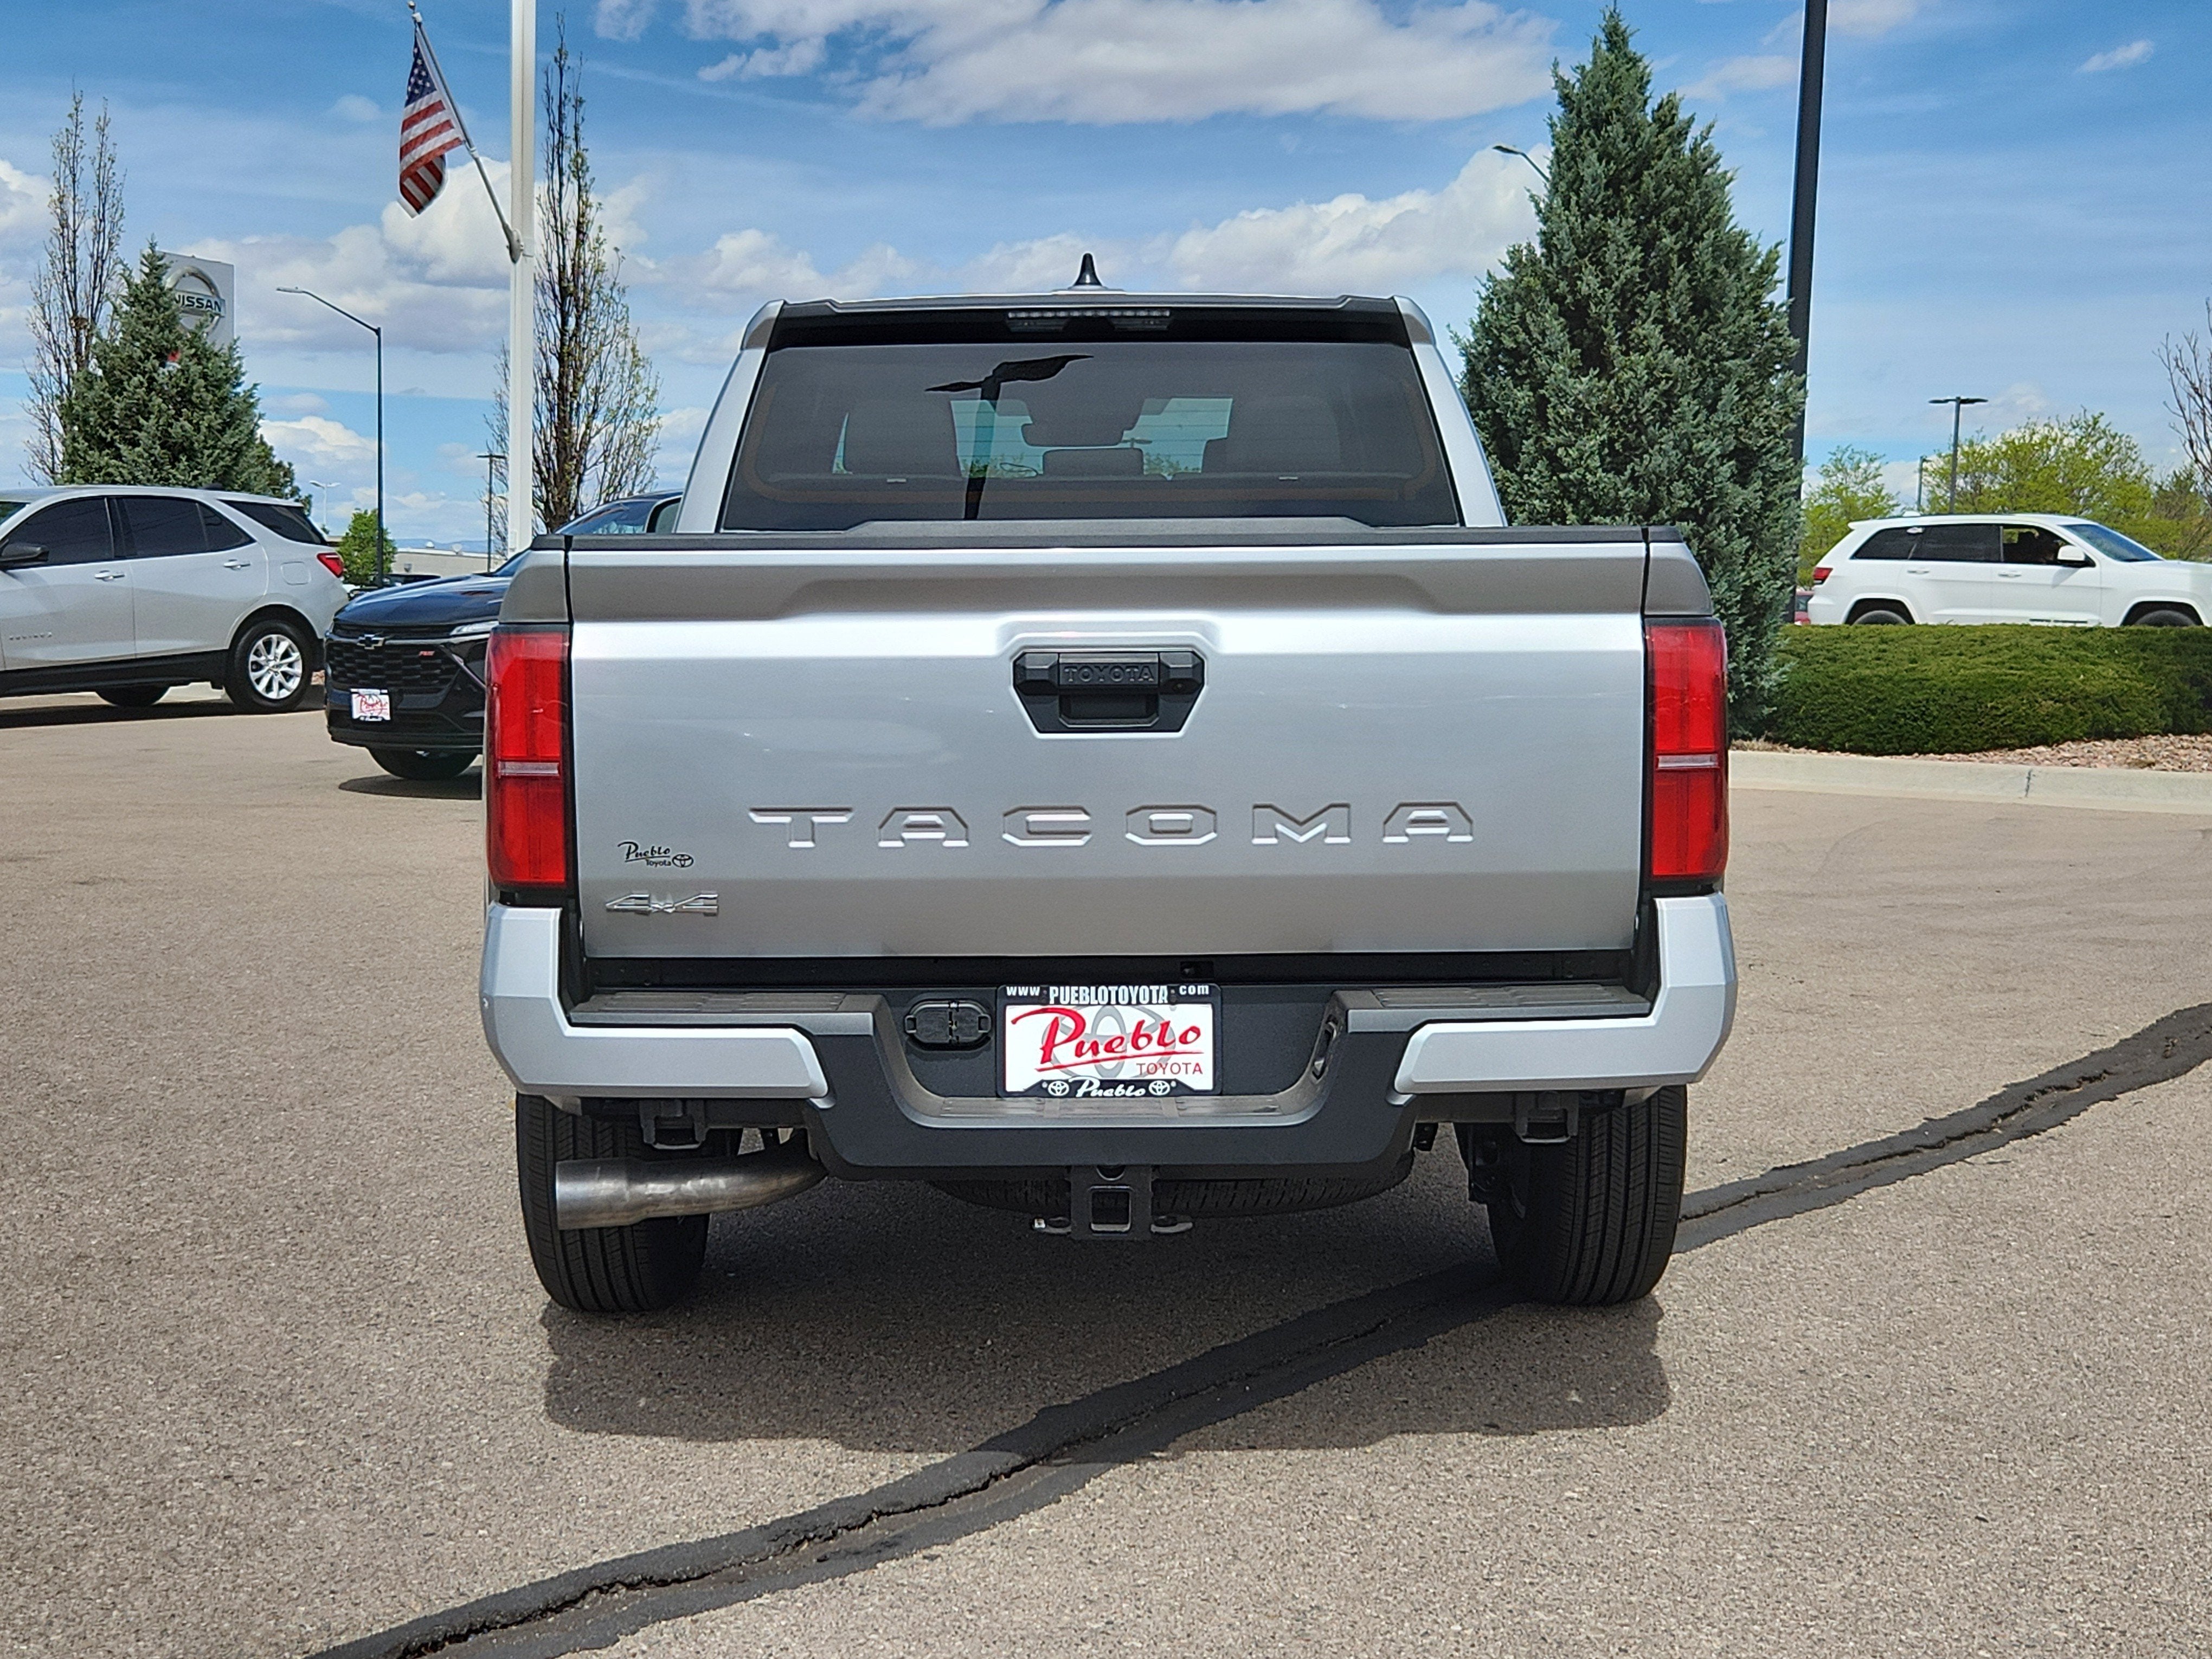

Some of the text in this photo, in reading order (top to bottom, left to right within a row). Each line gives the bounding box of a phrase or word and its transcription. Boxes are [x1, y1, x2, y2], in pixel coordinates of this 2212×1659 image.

[173, 294, 221, 312] NISSAN
[1064, 665, 1154, 682] TOYOTA
[749, 802, 1474, 848] TACOMA
[618, 841, 671, 859] Pueblo
[646, 859, 672, 867] Toyota
[1006, 985, 1209, 1005] www PUEBLOTOYOTA com
[1011, 1007, 1201, 1065] Pueblo
[1136, 1062, 1204, 1075] TOYOTA
[1068, 1076, 1147, 1097] Pueblo
